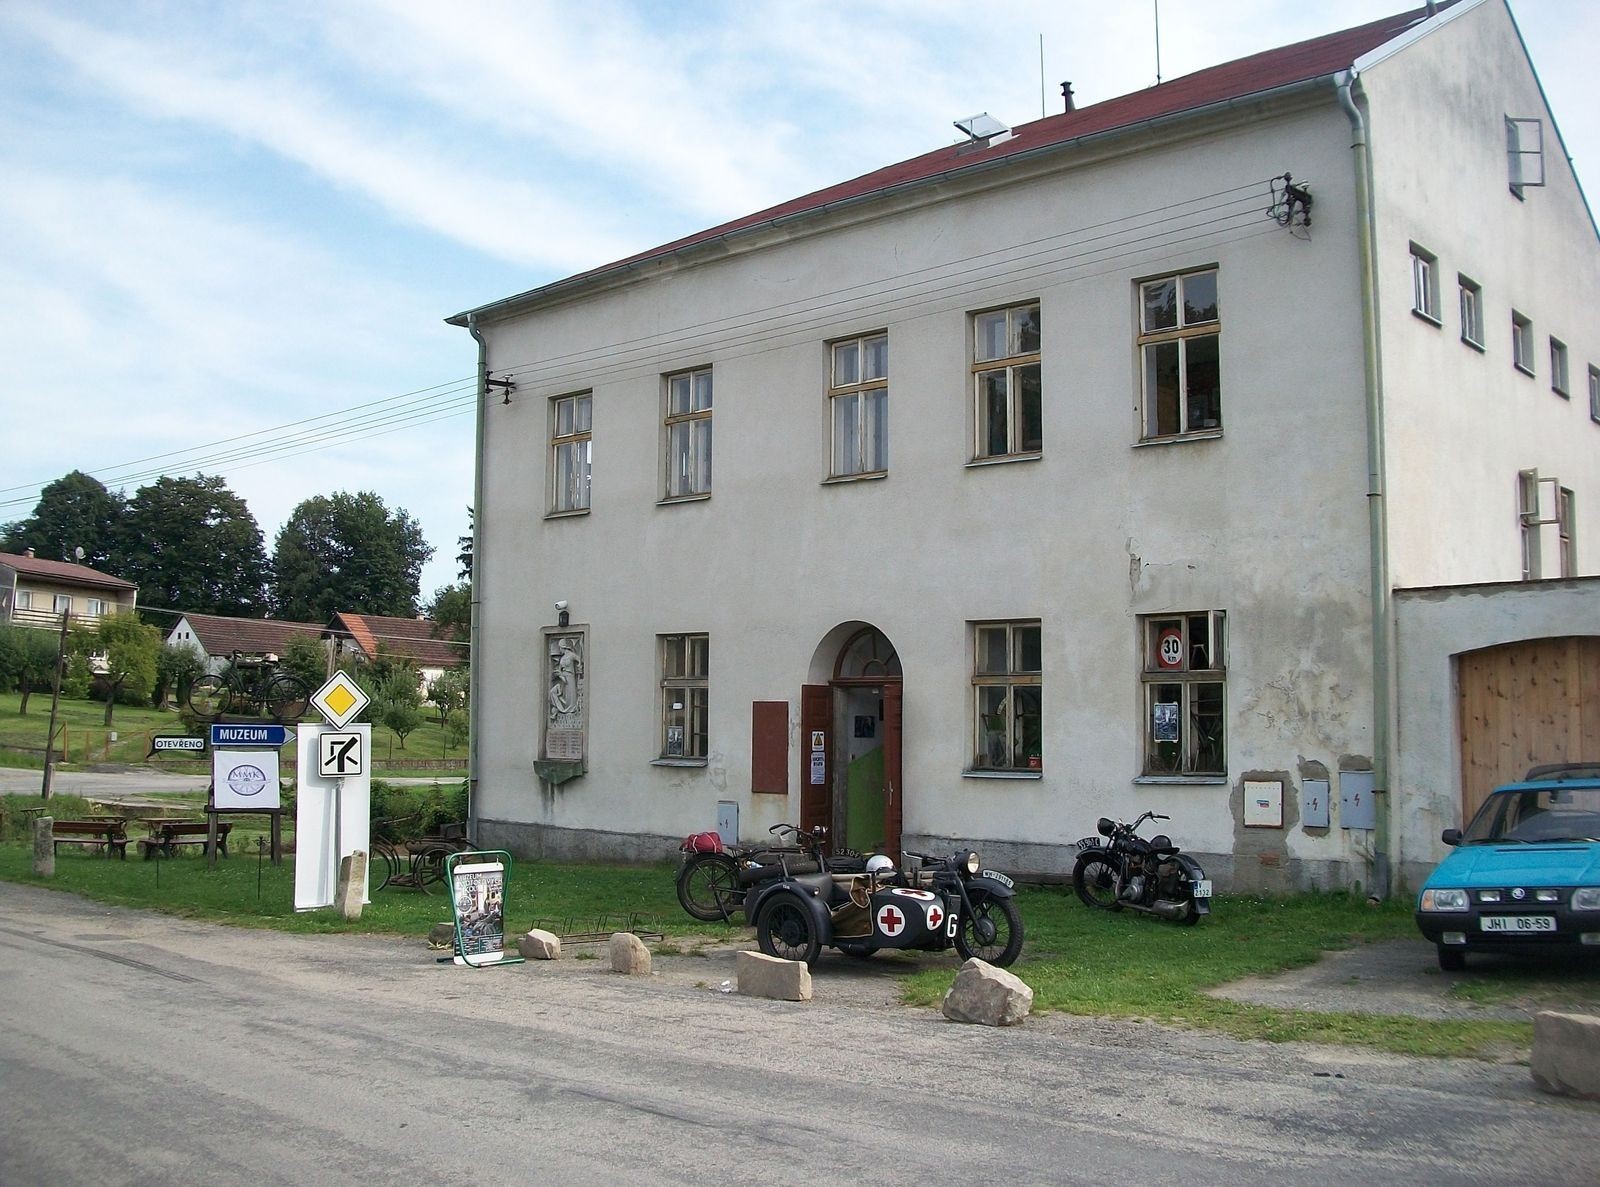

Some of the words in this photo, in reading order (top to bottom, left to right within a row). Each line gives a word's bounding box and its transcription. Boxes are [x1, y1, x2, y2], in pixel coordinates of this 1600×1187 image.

[1164, 639, 1179, 654] 30
[1167, 655, 1178, 663] km
[219, 729, 268, 740] MUZEUM
[156, 739, 203, 748] OTEVŘENO
[231, 771, 261, 779] MMK
[946, 913, 958, 938] G
[1487, 918, 1507, 930] JHI
[1516, 918, 1551, 930] 06-59
